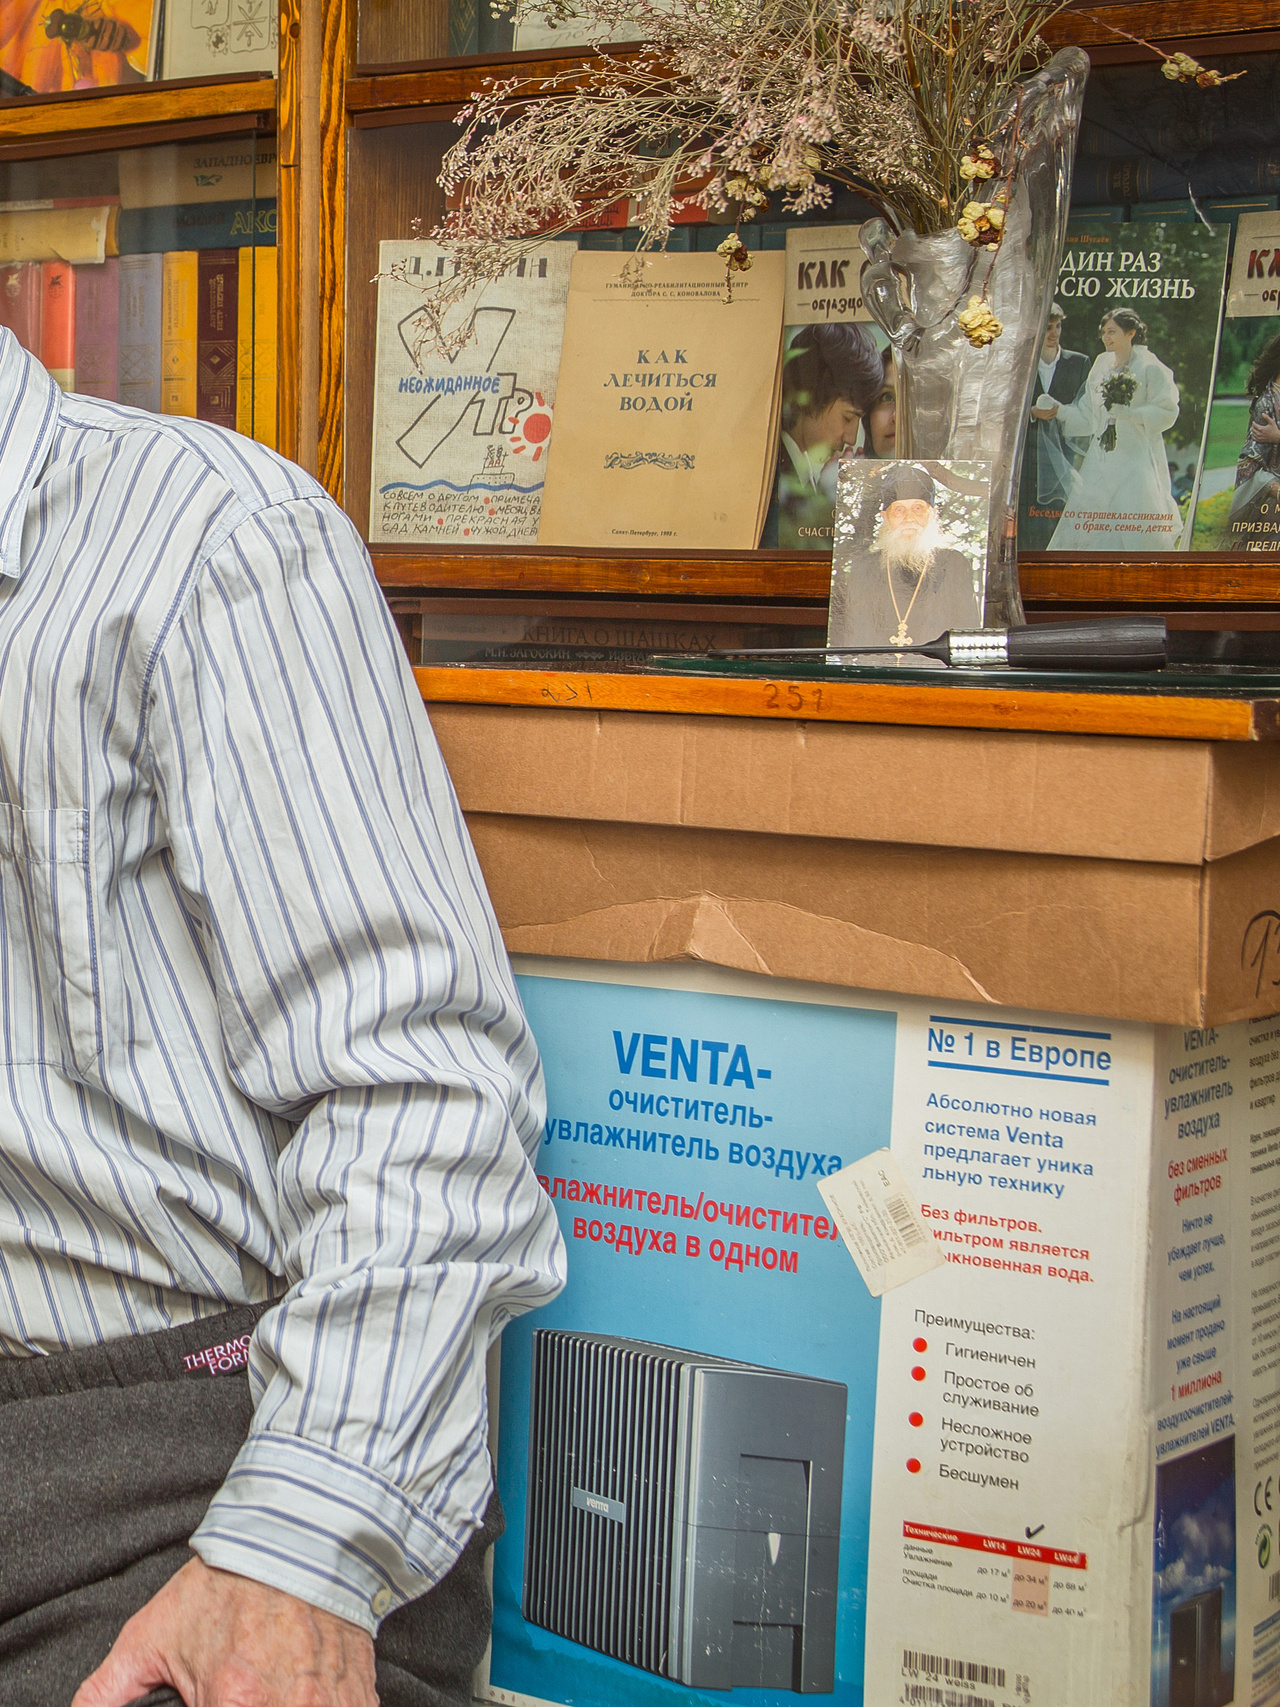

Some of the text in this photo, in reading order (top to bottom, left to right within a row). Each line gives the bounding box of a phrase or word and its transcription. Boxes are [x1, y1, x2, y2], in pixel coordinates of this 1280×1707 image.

[193, 153, 277, 168] ЗАПАДНОЕВР
[798, 260, 851, 290] КАК
[1059, 250, 1161, 276] ДИН РАЗ
[1247, 248, 1280, 279] КА
[1105, 278, 1196, 299] ЖИЗНЬ
[812, 297, 863, 319] ОБРАЗЦО
[637, 349, 688, 364] КАК
[398, 376, 501, 395] НЕОЖИДАННОЕ
[603, 373, 717, 388] ЛЕЧИТЬСЯ
[619, 391, 693, 413] ВОДОЙ
[383, 490, 424, 501] СОВСЕМ
[437, 493, 480, 502] ДРУГОМ
[392, 502, 484, 513] ПУТЕВОДИТЕЛЮ
[495, 506, 527, 516] МЕСЯЦ
[382, 511, 527, 525] НОГАМИ ПРЕКРАСНАЯ
[1029, 506, 1062, 519] Беседы
[1077, 511, 1173, 521] старшеклассниками
[1083, 520, 1112, 533] браке,
[1115, 524, 1144, 533] семье,
[1145, 524, 1173, 533] детях
[1232, 522, 1280, 533] ПРИЗВА
[382, 523, 408, 534] САД
[413, 523, 460, 535] КАМНЕЙ
[798, 527, 835, 537] СЧАСТЬ
[522, 625, 717, 650] КНИГА О ШАШКАХ
[928, 1027, 1112, 1071] № 1 в Европе
[1184, 1028, 1219, 1052] VENTA-
[612, 1030, 772, 1089] VENTA-
[1169, 1054, 1231, 1085] очиститель-
[608, 1089, 773, 1129] очиститель-
[926, 1092, 1097, 1127] Абсолютно новая
[1164, 1081, 1234, 1120] увлажнитель
[924, 1120, 1064, 1149] система Venta
[1177, 1112, 1221, 1139] воздуха
[544, 1117, 843, 1180] увлажнитель воздуха
[923, 1142, 1094, 1177] предлагает уника
[1168, 1159, 1185, 1179] без
[1186, 1148, 1228, 1173] сменных
[922, 1166, 1065, 1199] льную технику
[1174, 1175, 1222, 1206] фильтров
[921, 1204, 1043, 1234] Без фильтров.
[573, 1217, 799, 1273] воздуха в одном
[931, 1227, 1090, 1262] ильтром является
[1047, 1262, 1095, 1284] вода.
[914, 1309, 1036, 1341] Преимущества:
[183, 1334, 251, 1371] THERMO
[945, 1342, 1037, 1370] Гигиеничен
[1176, 1347, 1217, 1374] уже свыше
[944, 1370, 1034, 1398] Простое об
[1178, 1370, 1222, 1398] миллиона
[942, 1389, 1040, 1418] служивание
[940, 1417, 1032, 1446] Несложное
[939, 1435, 1030, 1464] устройство
[938, 1464, 1020, 1491] Бесшумен
[904, 1524, 959, 1542] Технические
[945, 1678, 976, 1690] weiss
